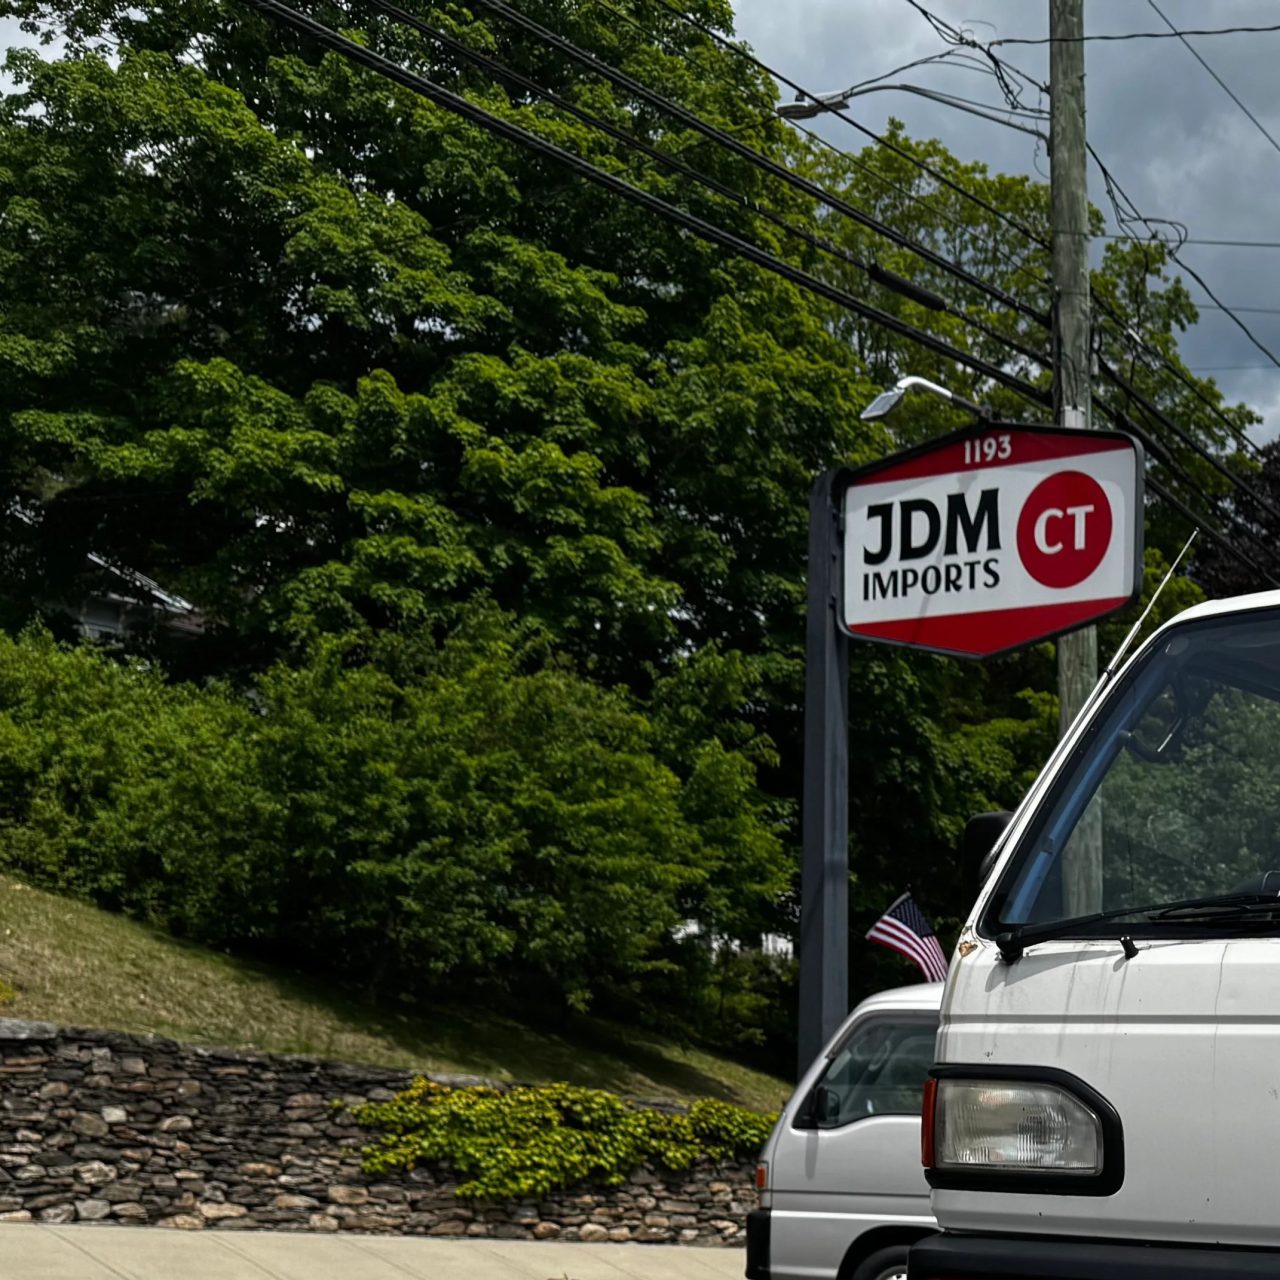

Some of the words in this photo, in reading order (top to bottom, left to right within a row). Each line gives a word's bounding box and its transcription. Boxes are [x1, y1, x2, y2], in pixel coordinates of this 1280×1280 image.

[964, 435, 1012, 464] 1193
[863, 488, 1001, 565] JDM
[1034, 504, 1095, 555] CT
[863, 558, 1000, 601] IMPORTS
